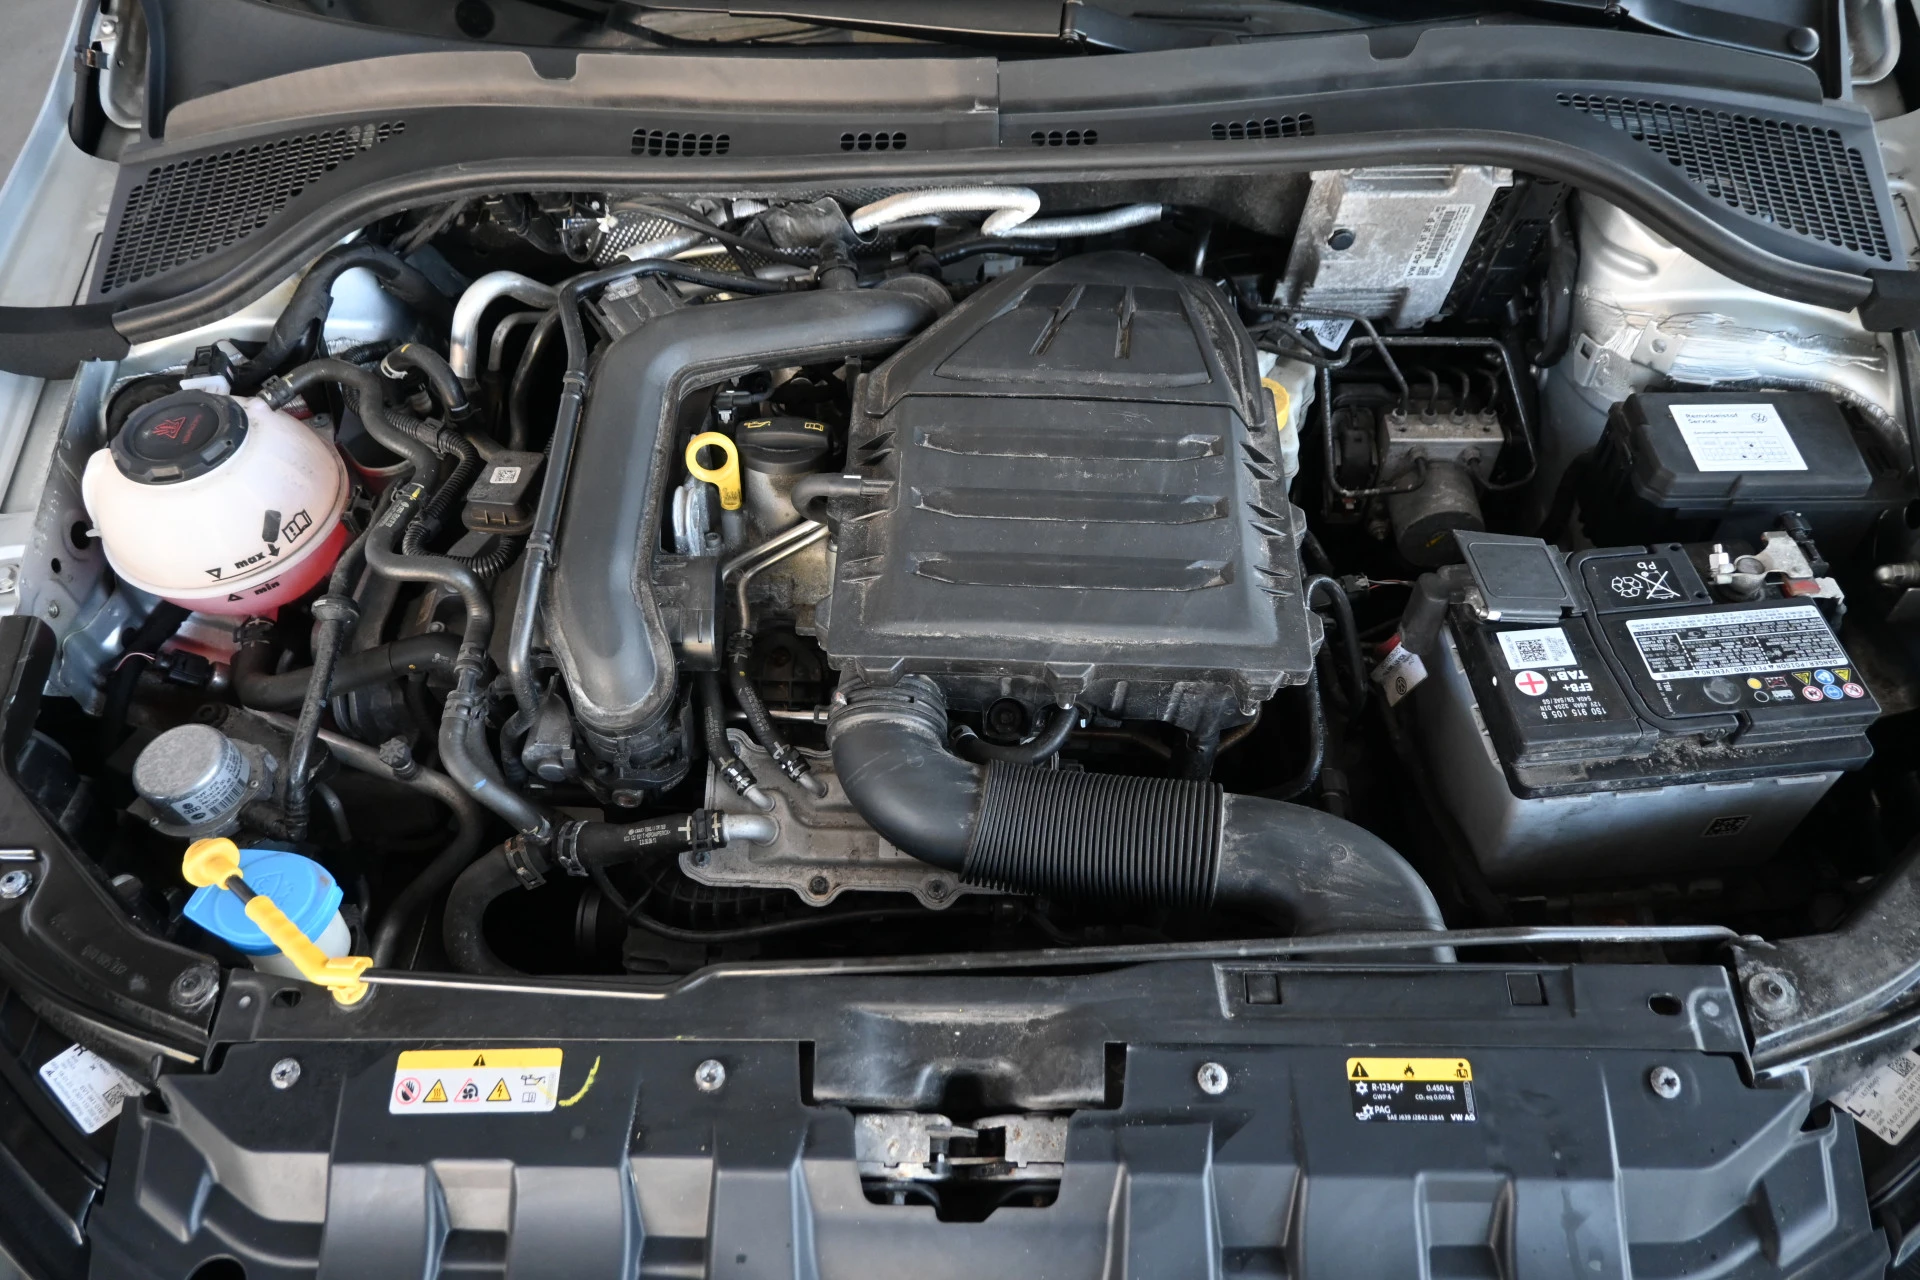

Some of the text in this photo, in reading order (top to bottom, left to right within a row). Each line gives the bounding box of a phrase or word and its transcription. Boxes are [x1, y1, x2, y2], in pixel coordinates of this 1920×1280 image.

[234, 551, 266, 568] max
[1636, 561, 1656, 569] Pb
[254, 580, 280, 594] min
[1556, 669, 1588, 680] TAB
[1562, 682, 1593, 692] EFB+
[1571, 708, 1587, 716] 915
[1371, 1082, 1403, 1093] R-1234yf
[1445, 1083, 1454, 1093] kg
[1374, 1105, 1390, 1113] PAG
[1846, 1106, 1865, 1117] L
